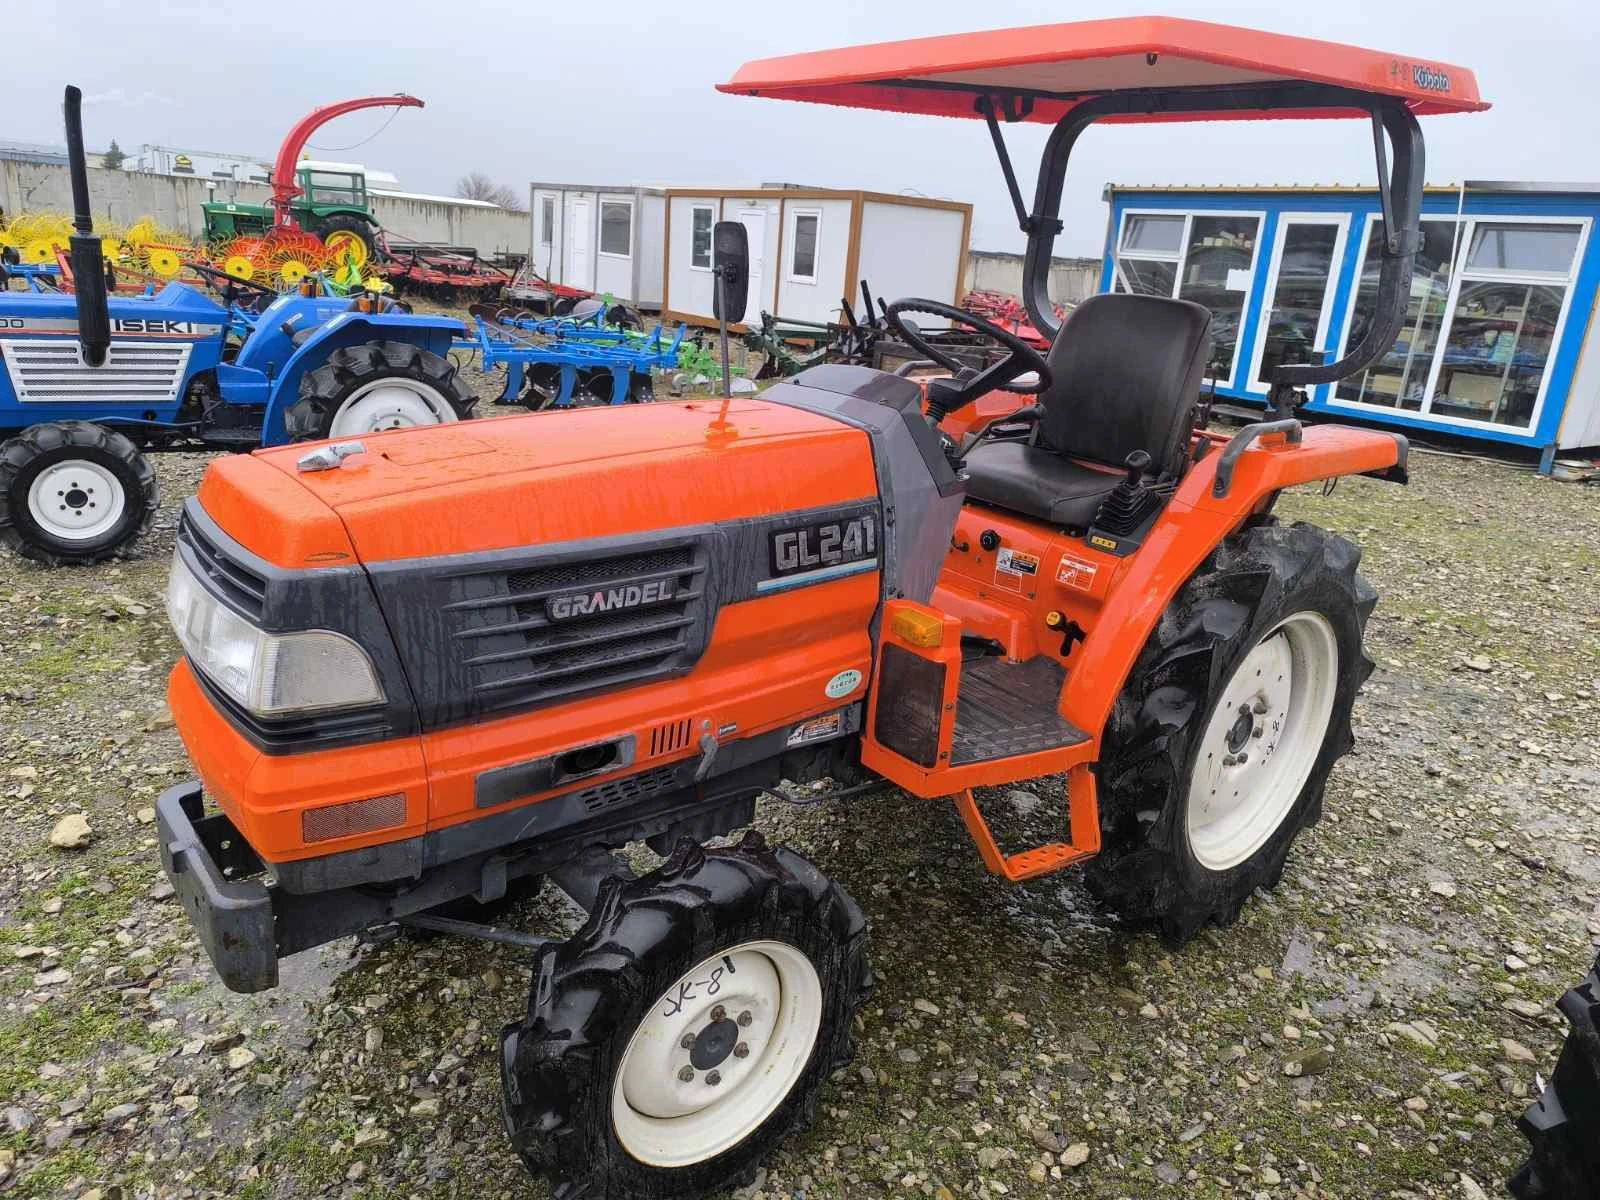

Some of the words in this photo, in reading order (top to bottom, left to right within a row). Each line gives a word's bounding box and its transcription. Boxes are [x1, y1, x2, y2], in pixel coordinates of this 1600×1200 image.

[1412, 64, 1450, 92] Kubota
[115, 318, 193, 334] ISEKI
[775, 515, 876, 571] GL241
[552, 580, 674, 619] GRANDEL
